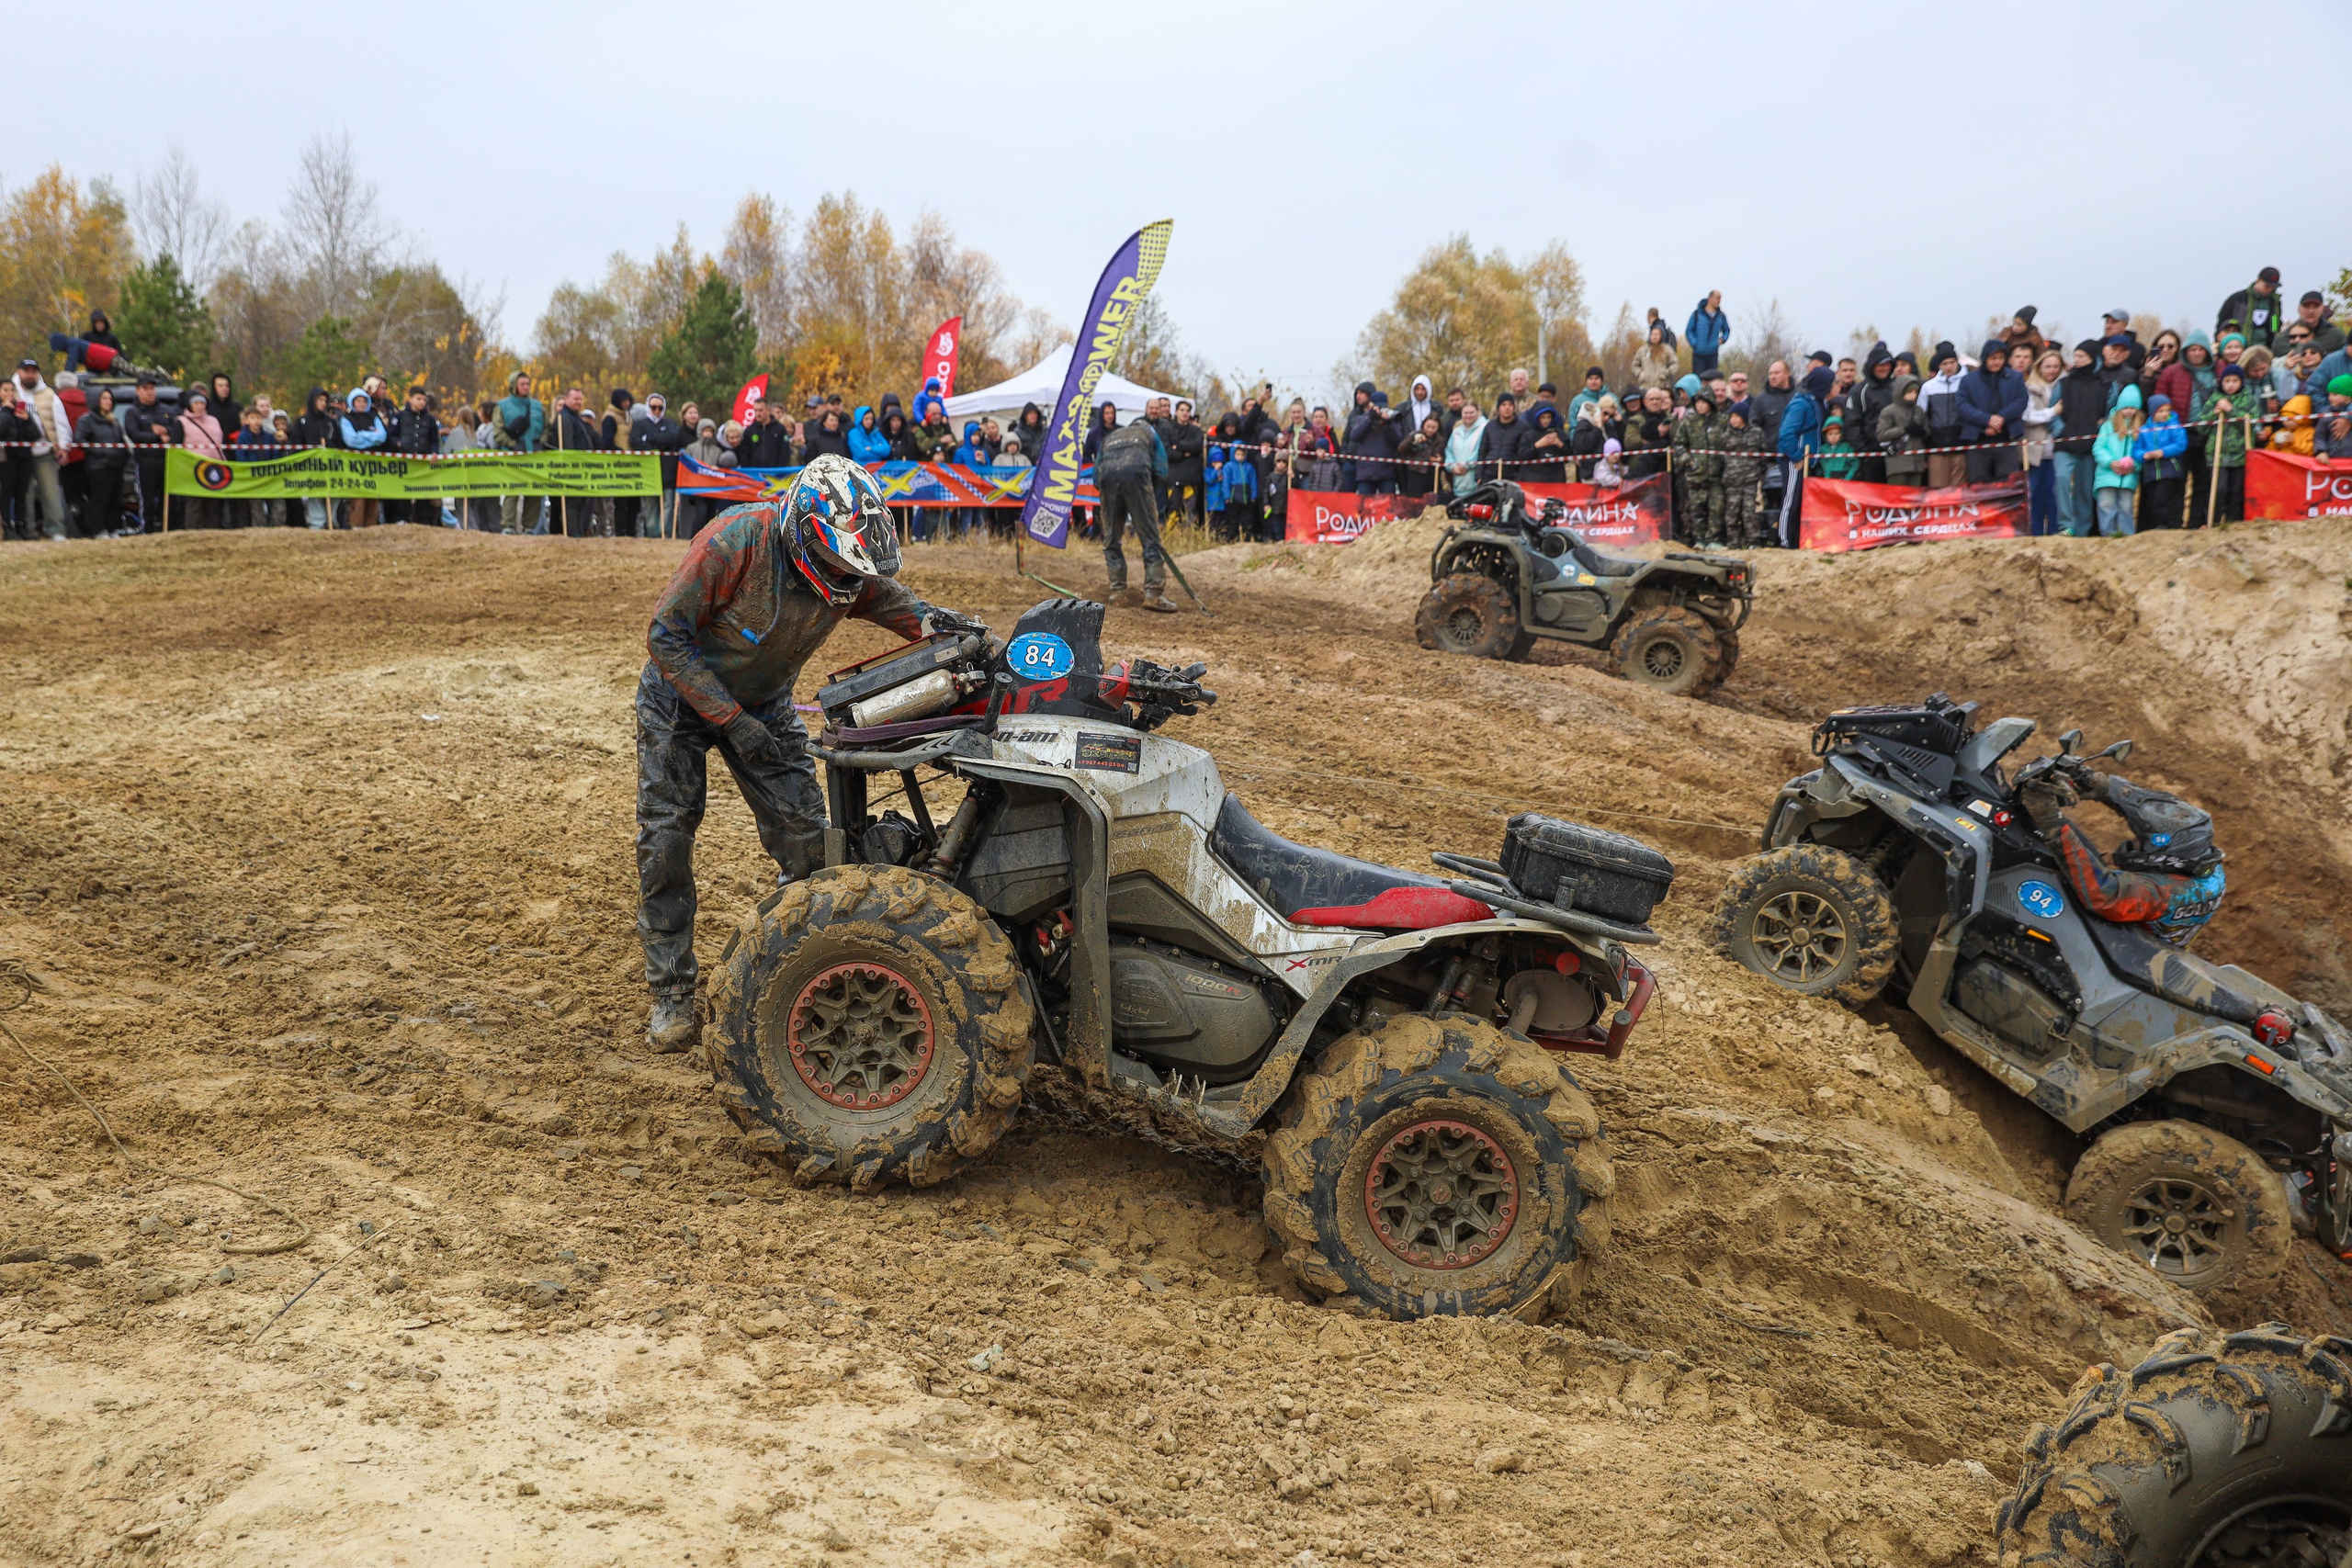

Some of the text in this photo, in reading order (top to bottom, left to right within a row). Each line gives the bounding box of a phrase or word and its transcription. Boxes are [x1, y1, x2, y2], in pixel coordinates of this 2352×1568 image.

[349, 459, 409, 478] курьер
[1589, 525, 1635, 536] СЕРДЦАХ
[1861, 526, 1908, 538] НАШИХ
[1913, 522, 1977, 536] СЕРДЦАХ
[1024, 644, 1056, 668] 84
[2029, 888, 2052, 909] 94
[1184, 973, 1241, 997] 1000R
